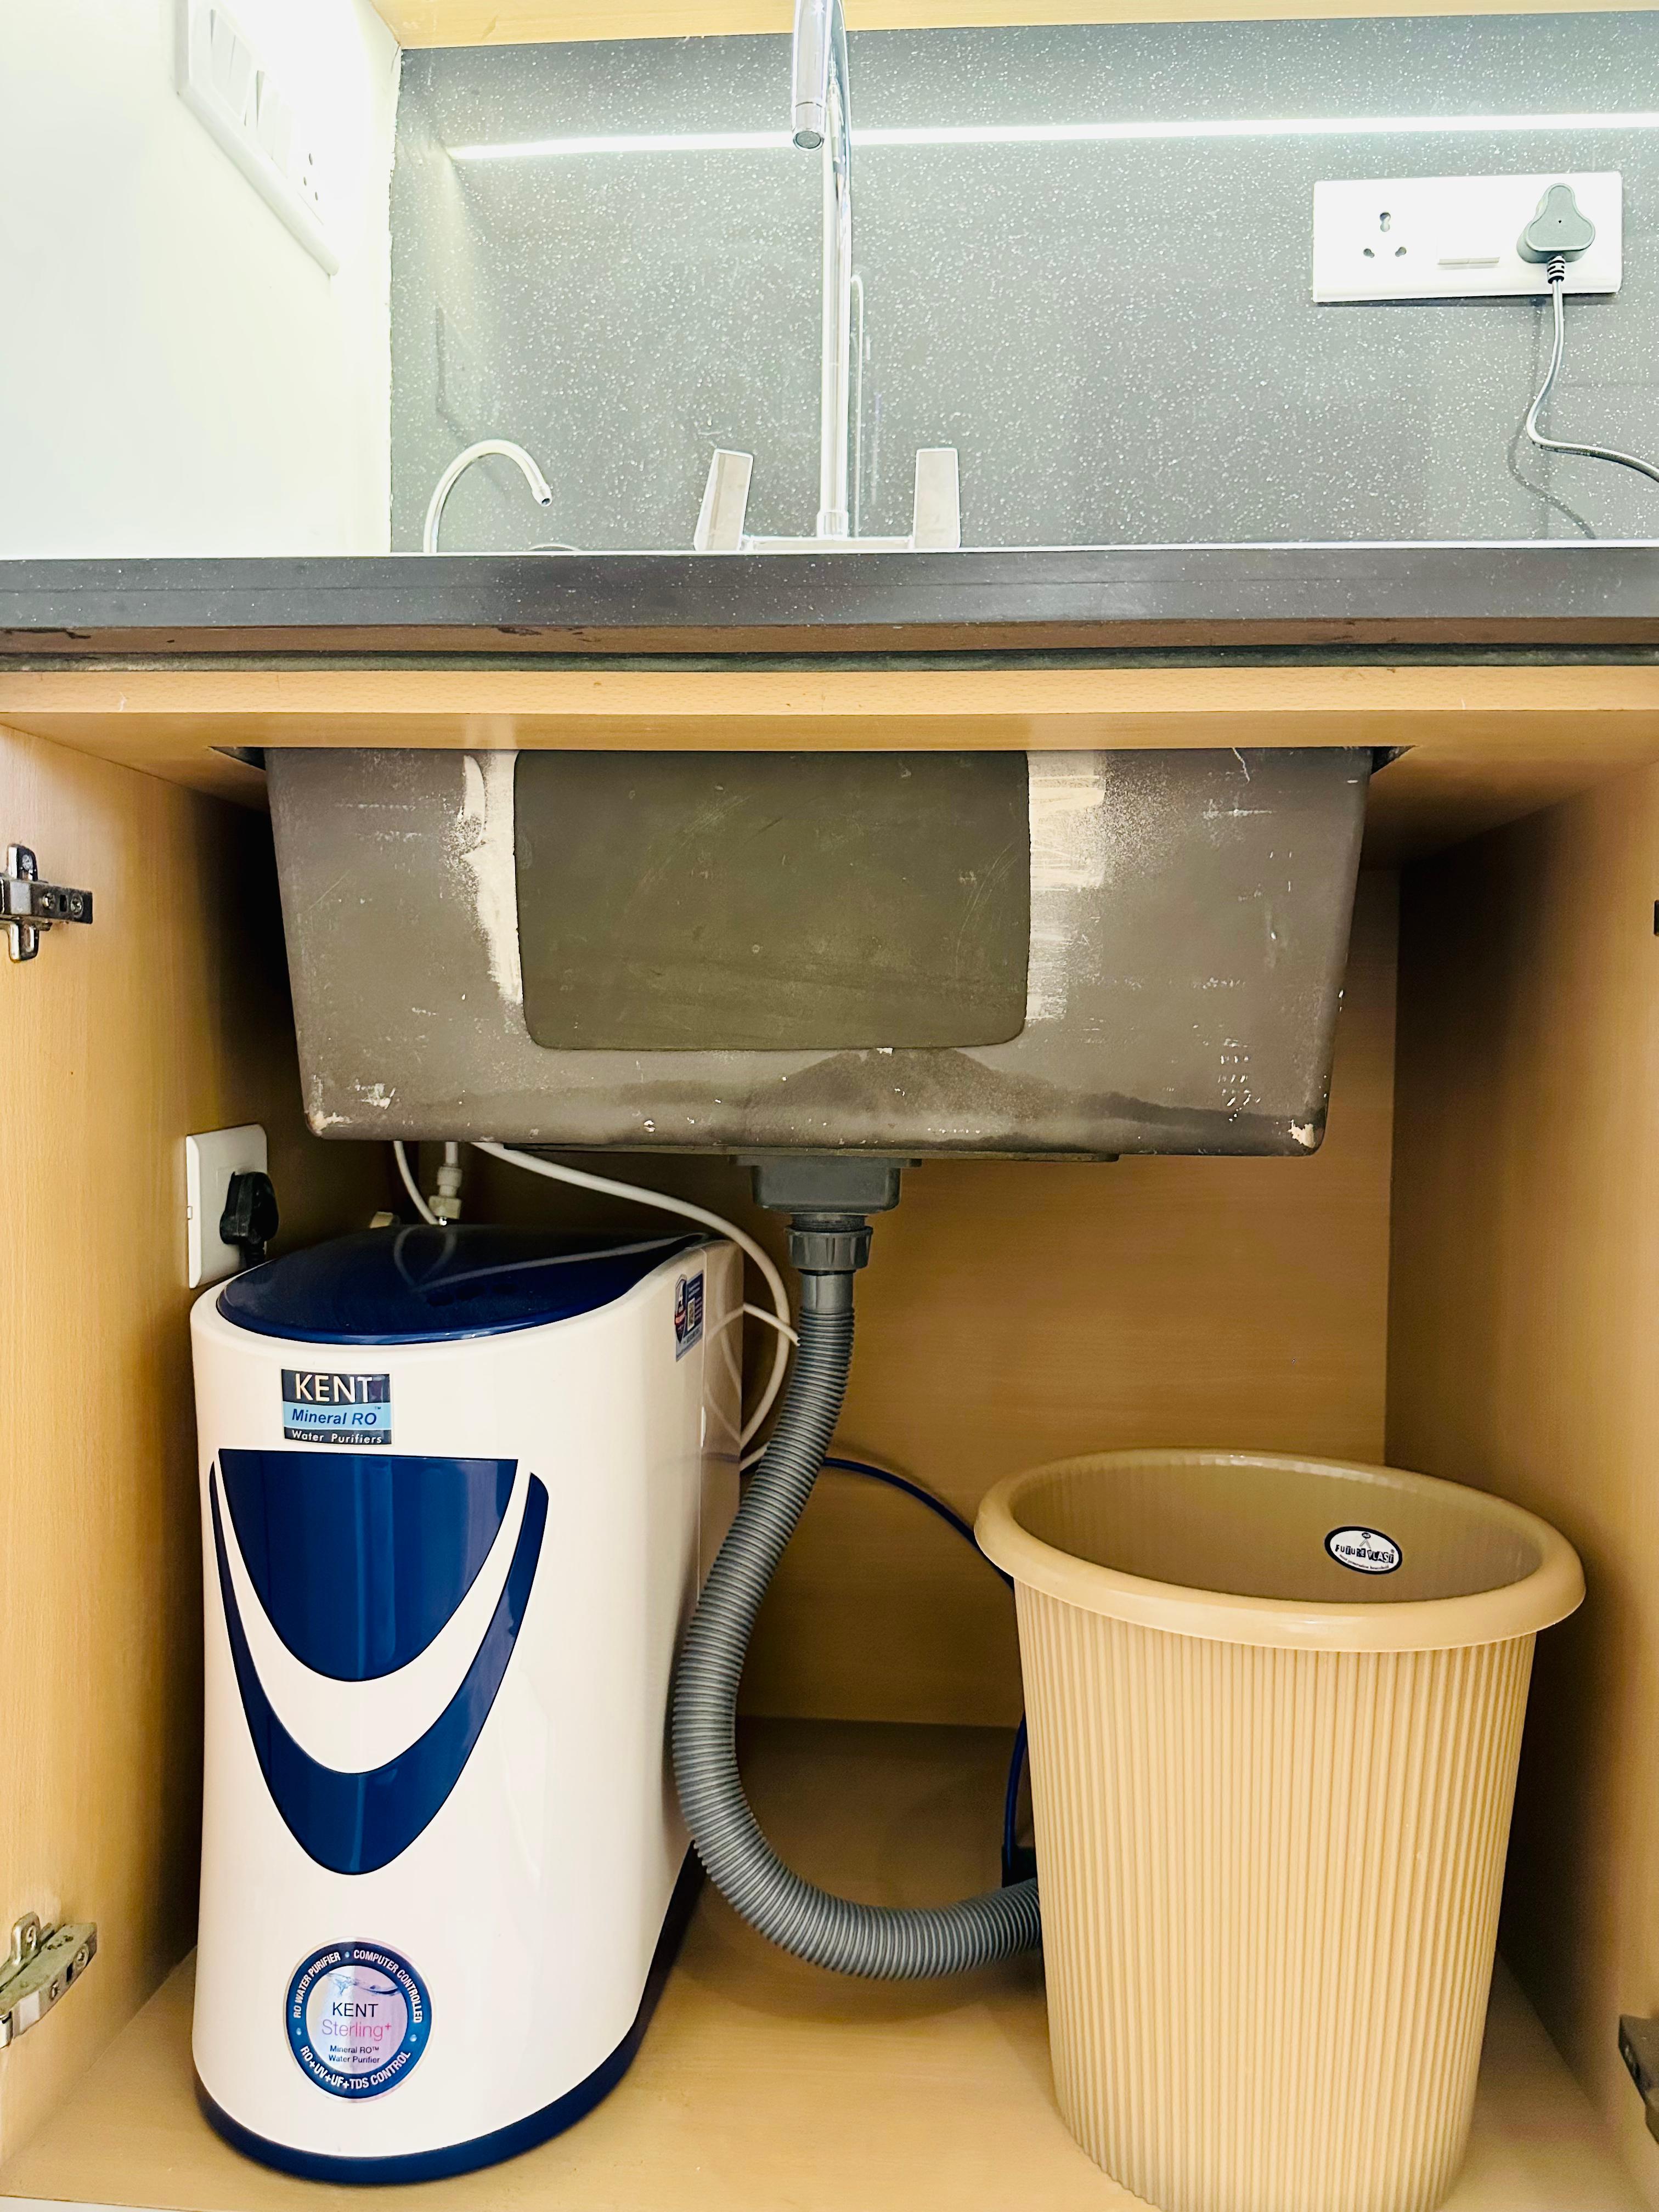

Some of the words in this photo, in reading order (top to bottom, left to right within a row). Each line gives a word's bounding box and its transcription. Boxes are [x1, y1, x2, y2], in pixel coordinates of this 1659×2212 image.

[295, 1373, 373, 1403] KENT
[292, 1408, 347, 1425] Mineral
[292, 1429, 324, 1442] Water
[331, 1433, 382, 1444] Purifiers
[1335, 1544, 1366, 1558] FUTURE
[308, 1951, 341, 1978] PURIFIER
[295, 1974, 312, 2005] WATER
[353, 1949, 399, 1973] COMPUTER
[397, 1969, 423, 2023] CONTROLLED
[293, 2005, 301, 2019] RO
[332, 2002, 379, 2018] KENT
[330, 2045, 357, 2053] Mineral
[329, 2054, 350, 2063] Water
[352, 2056, 380, 2064] Purifier
[370, 2051, 411, 2086] CONTROL
